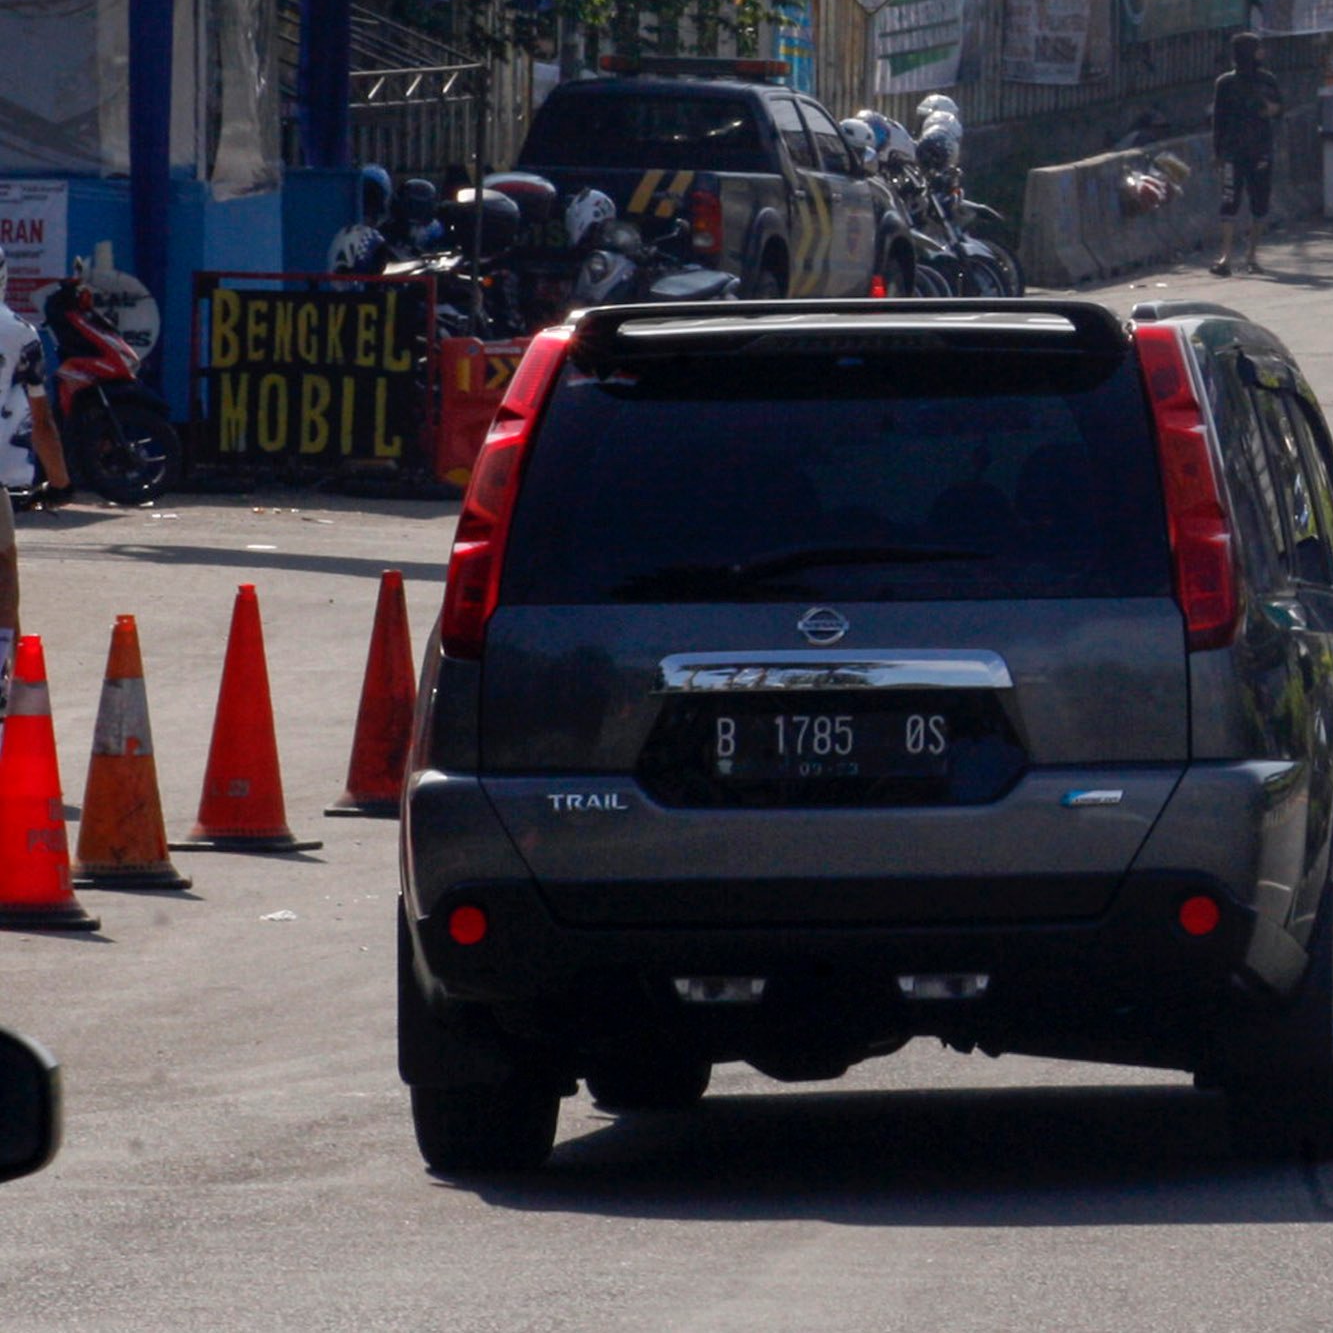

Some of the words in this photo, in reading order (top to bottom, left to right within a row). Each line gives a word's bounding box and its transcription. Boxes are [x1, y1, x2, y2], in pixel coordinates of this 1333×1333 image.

[210, 287, 412, 372] BENGKEL
[218, 372, 403, 458] MOBIL
[716, 717, 736, 758] B
[774, 715, 854, 756] 1785
[547, 793, 630, 812] TRAIL
